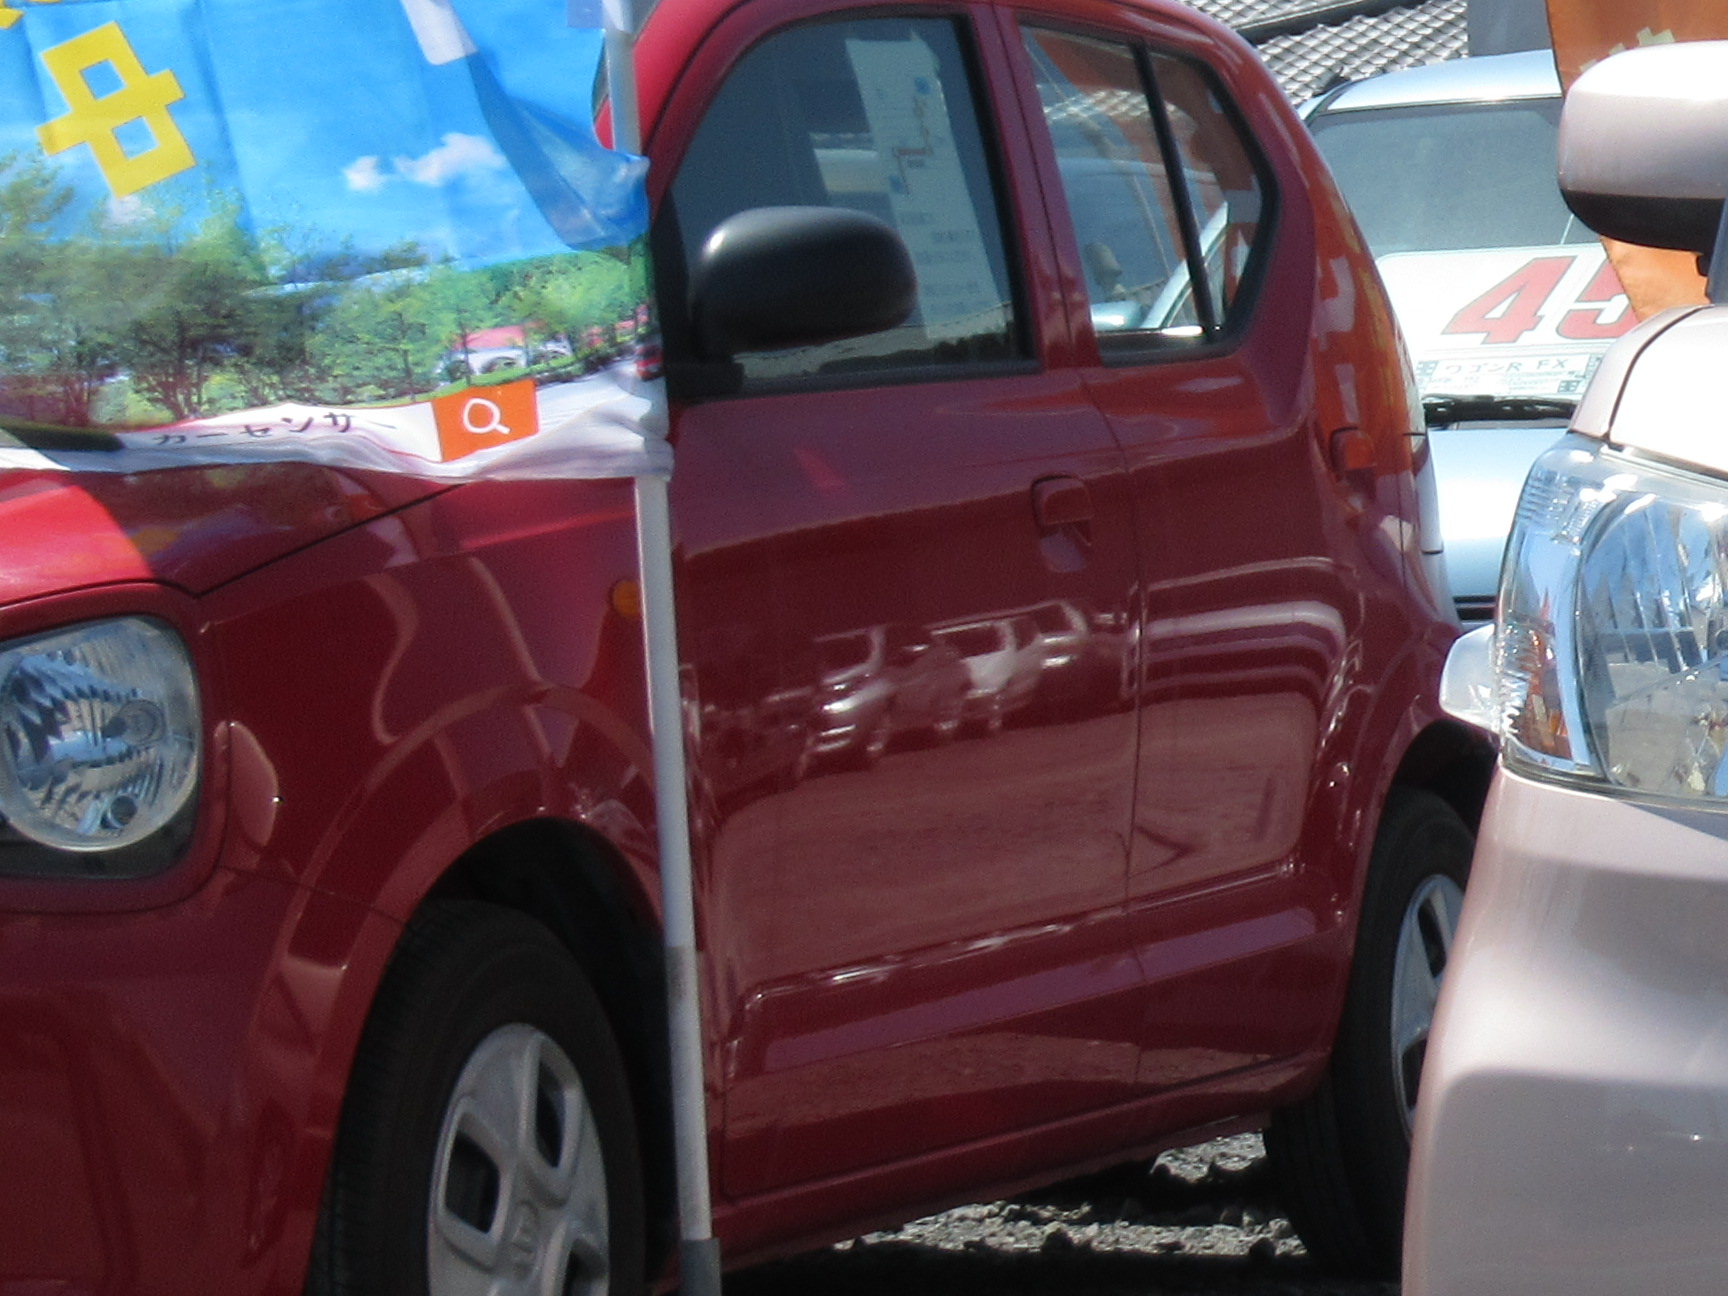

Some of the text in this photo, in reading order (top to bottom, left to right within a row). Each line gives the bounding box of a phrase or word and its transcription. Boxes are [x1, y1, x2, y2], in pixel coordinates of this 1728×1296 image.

[1537, 358, 1568, 370] FX
[152, 411, 397, 446] カーセンサー
